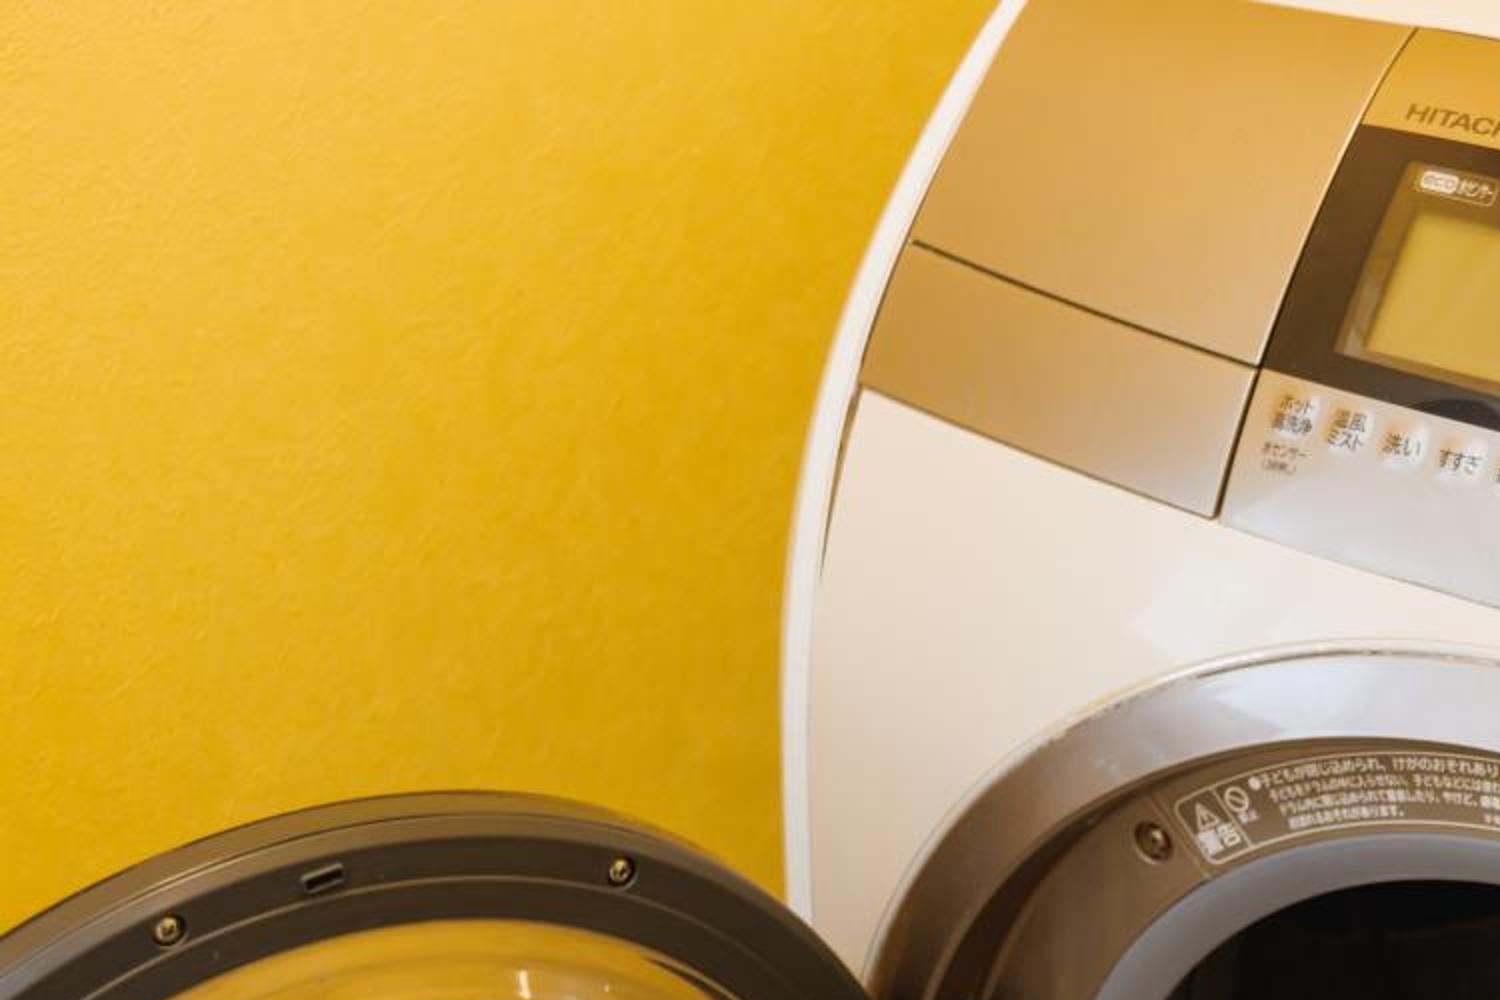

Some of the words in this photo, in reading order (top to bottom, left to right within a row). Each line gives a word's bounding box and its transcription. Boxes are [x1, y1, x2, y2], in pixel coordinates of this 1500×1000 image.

[1381, 431, 1421, 457] 洗い
[1438, 447, 1483, 476] すすぎ
